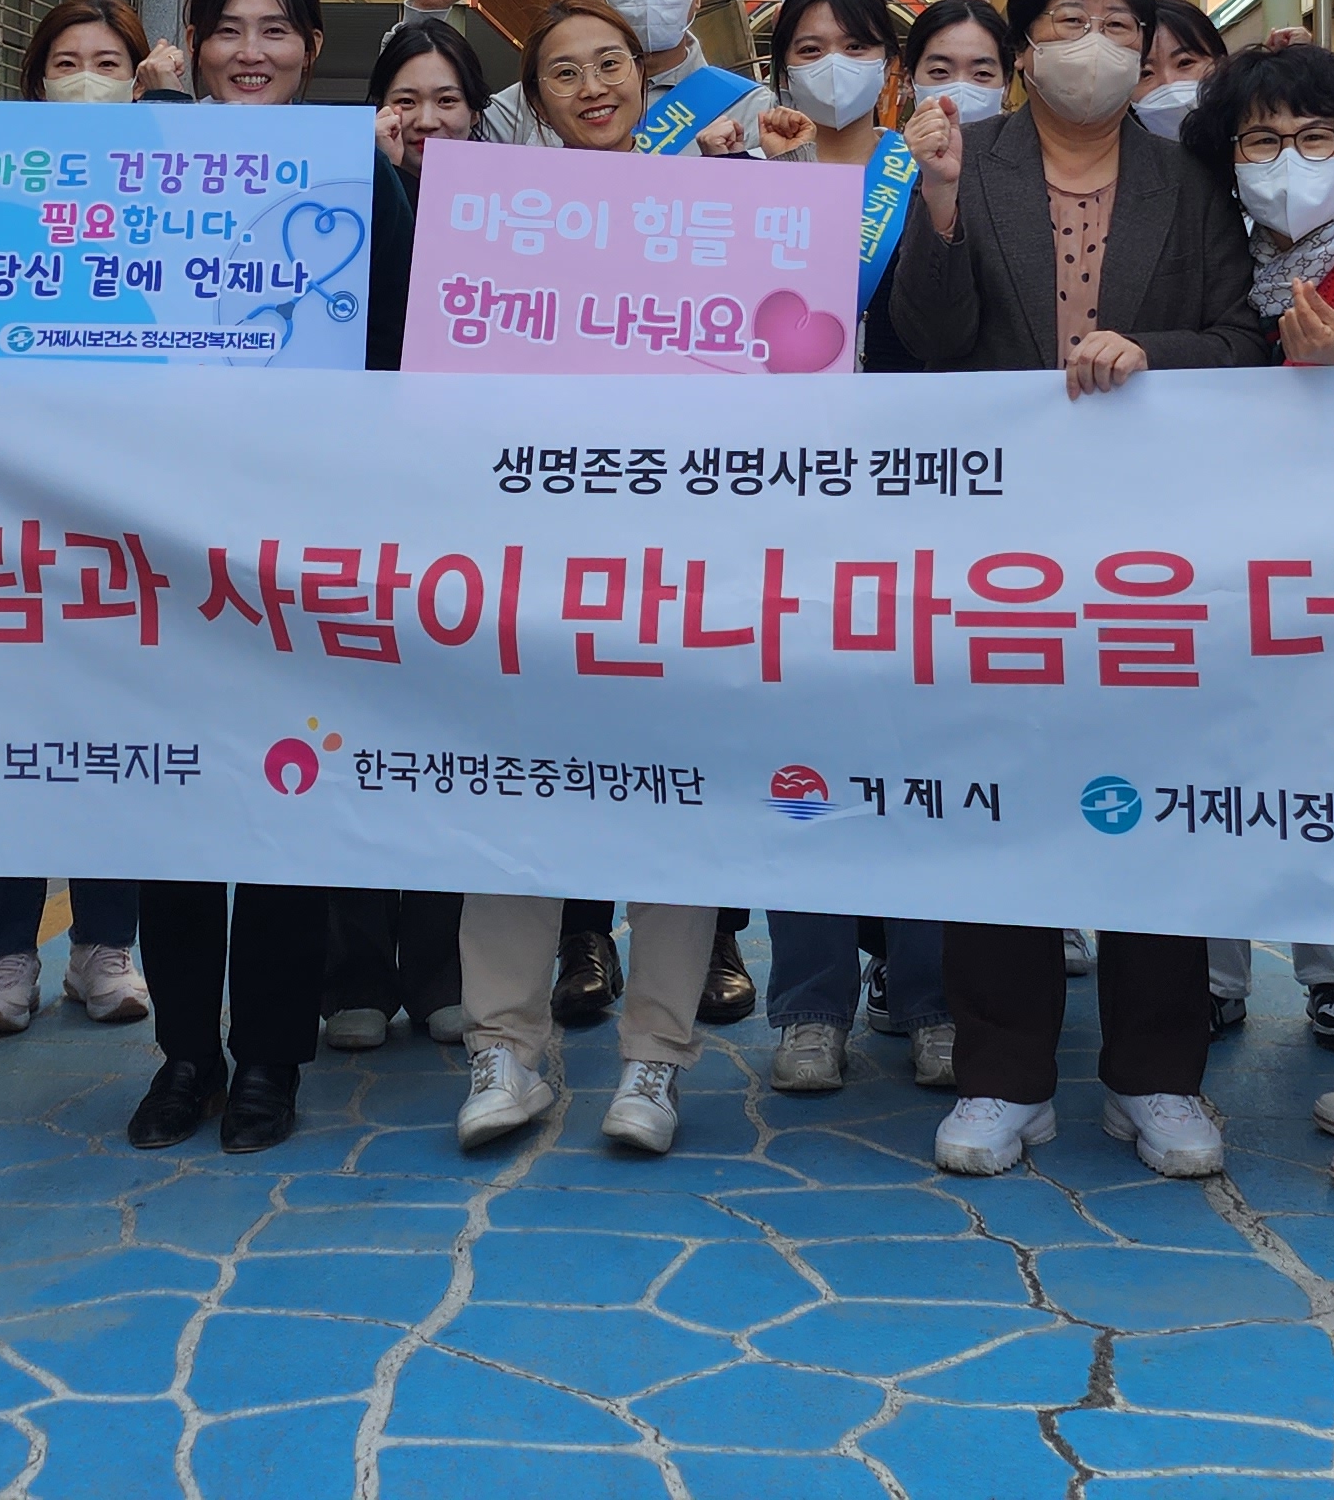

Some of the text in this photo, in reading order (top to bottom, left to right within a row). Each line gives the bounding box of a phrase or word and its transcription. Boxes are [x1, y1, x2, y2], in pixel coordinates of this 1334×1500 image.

[109, 152, 309, 195] 건강검진이
[41, 202, 253, 244] 필요합니다.
[449, 188, 812, 271] 마음이 힘들 땐
[83, 255, 163, 298] 곁에
[184, 256, 309, 299] 언제나
[36, 329, 277, 351] 거제시보건소 정신건강복지센터
[439, 274, 769, 362] 함께 나눠요.
[491, 444, 1005, 499] 생명존중 생명사랑 캠페인
[196, 538, 526, 677] 사람이
[559, 545, 801, 684] 만나
[830, 546, 1209, 688] 마음을
[1, 740, 203, 787] 보건복지부
[352, 746, 706, 809] 한국생명존중희망재단
